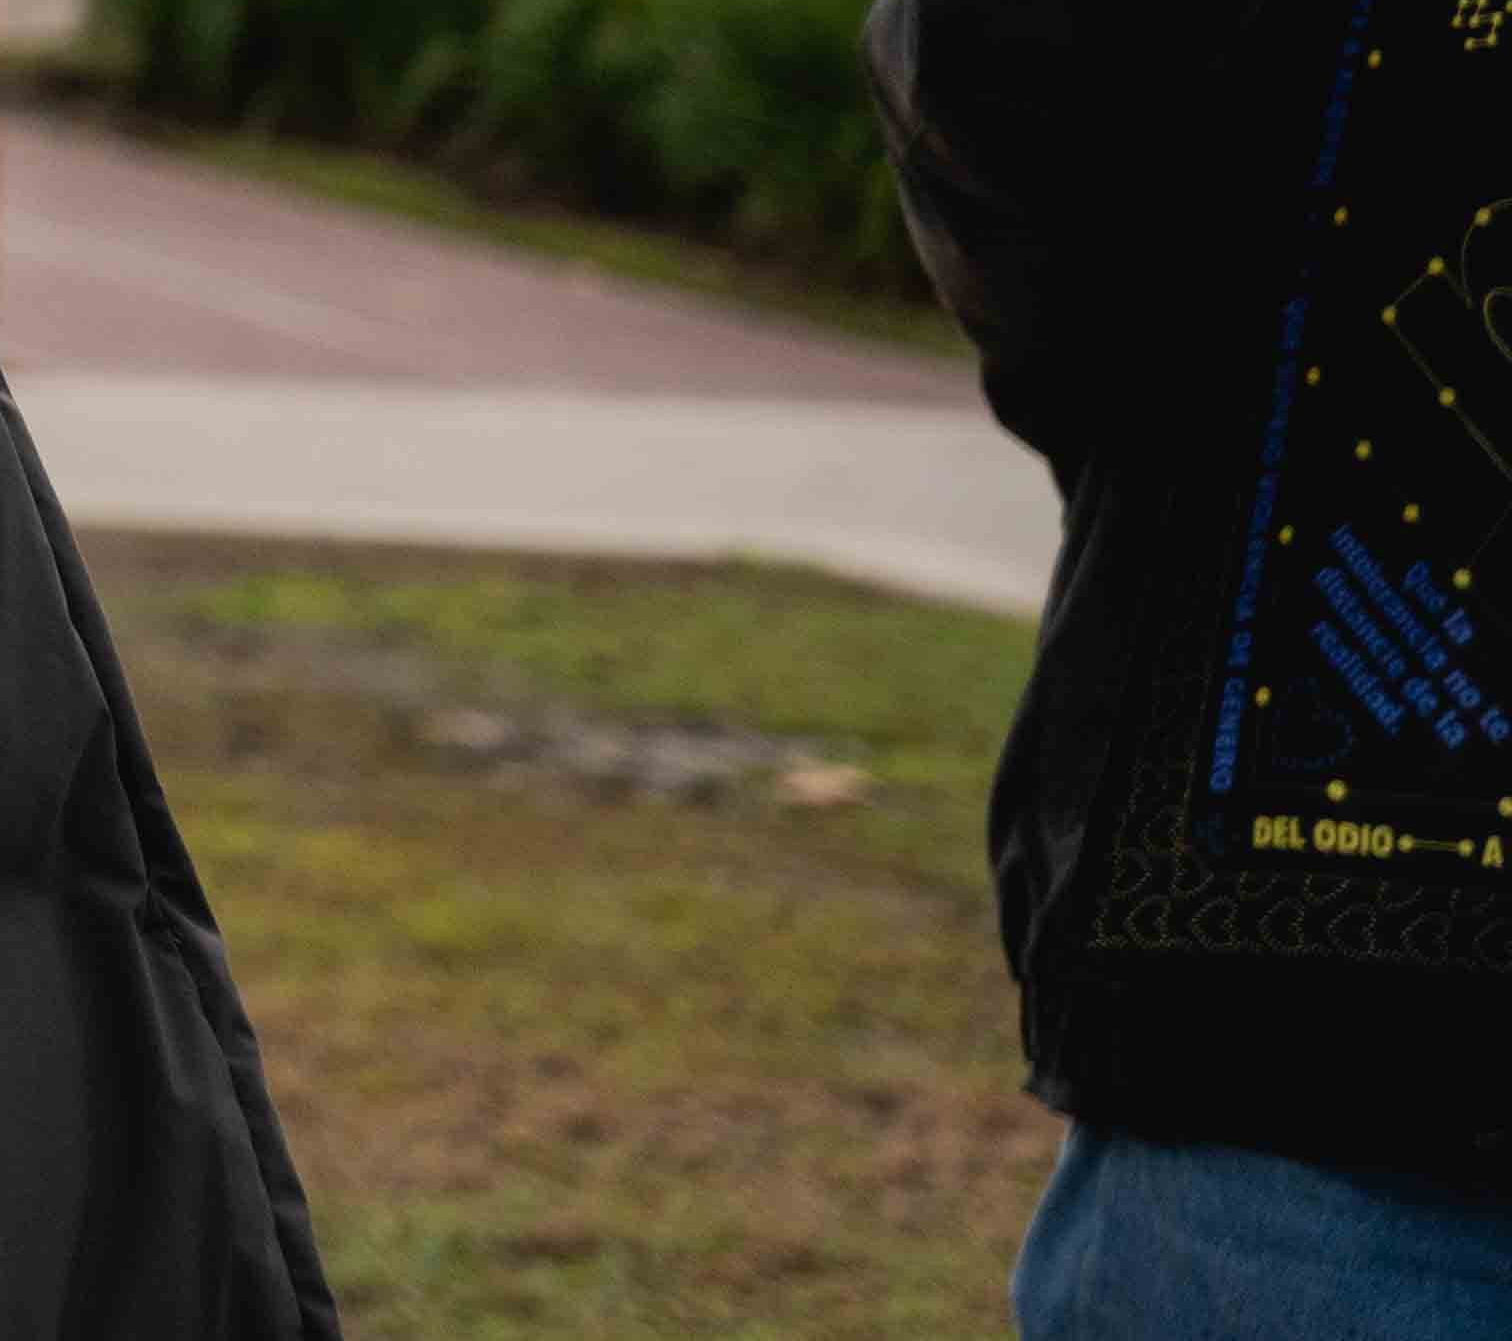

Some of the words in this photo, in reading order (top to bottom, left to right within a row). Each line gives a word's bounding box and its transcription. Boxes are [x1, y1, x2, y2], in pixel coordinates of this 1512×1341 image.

[1251, 814, 1308, 852] DEL
[1313, 818, 1396, 861] ODIO
[1479, 833, 1505, 870] A
